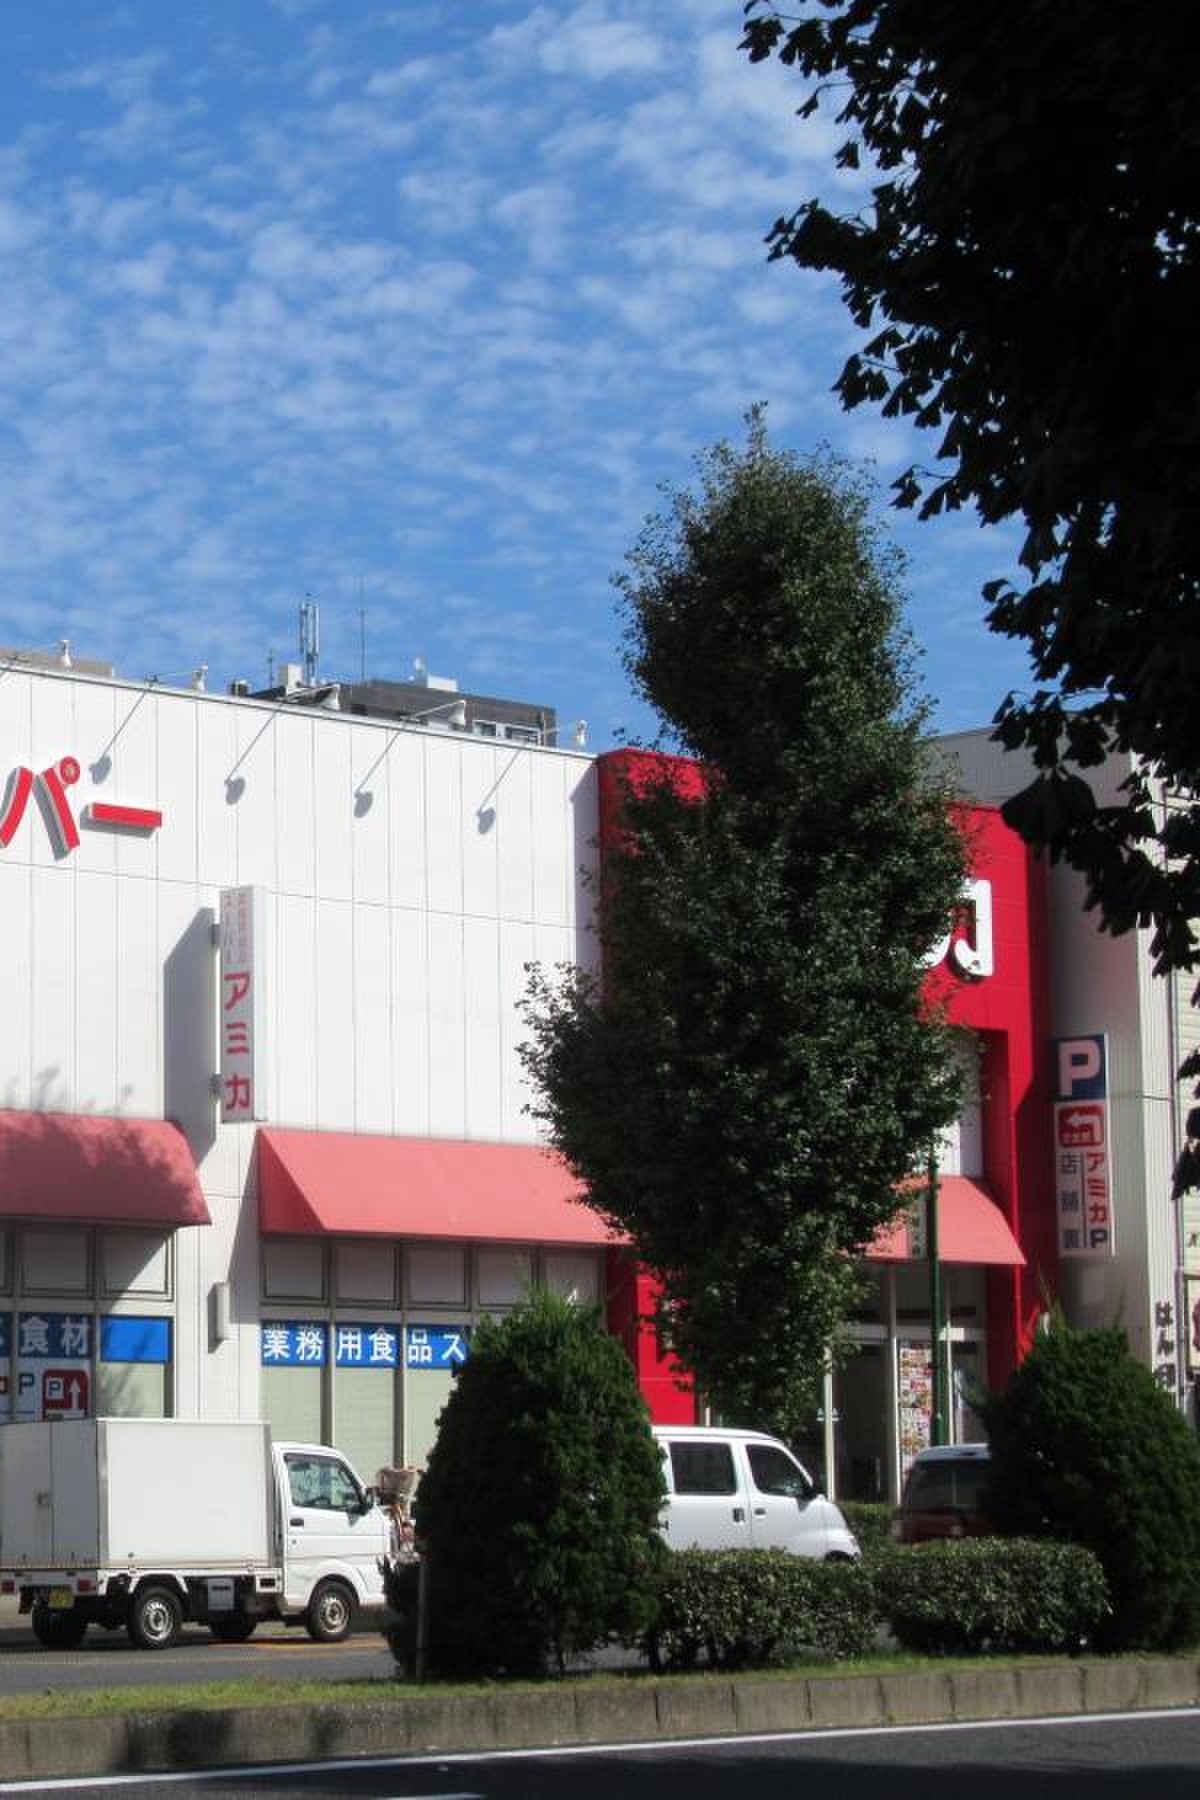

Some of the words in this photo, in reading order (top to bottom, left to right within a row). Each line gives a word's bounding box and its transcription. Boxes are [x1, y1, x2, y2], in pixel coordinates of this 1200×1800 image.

[223, 971, 250, 1111] アミカ
[1059, 1039, 1101, 1096] P
[263, 1326, 465, 1363] 業務用食品ス
